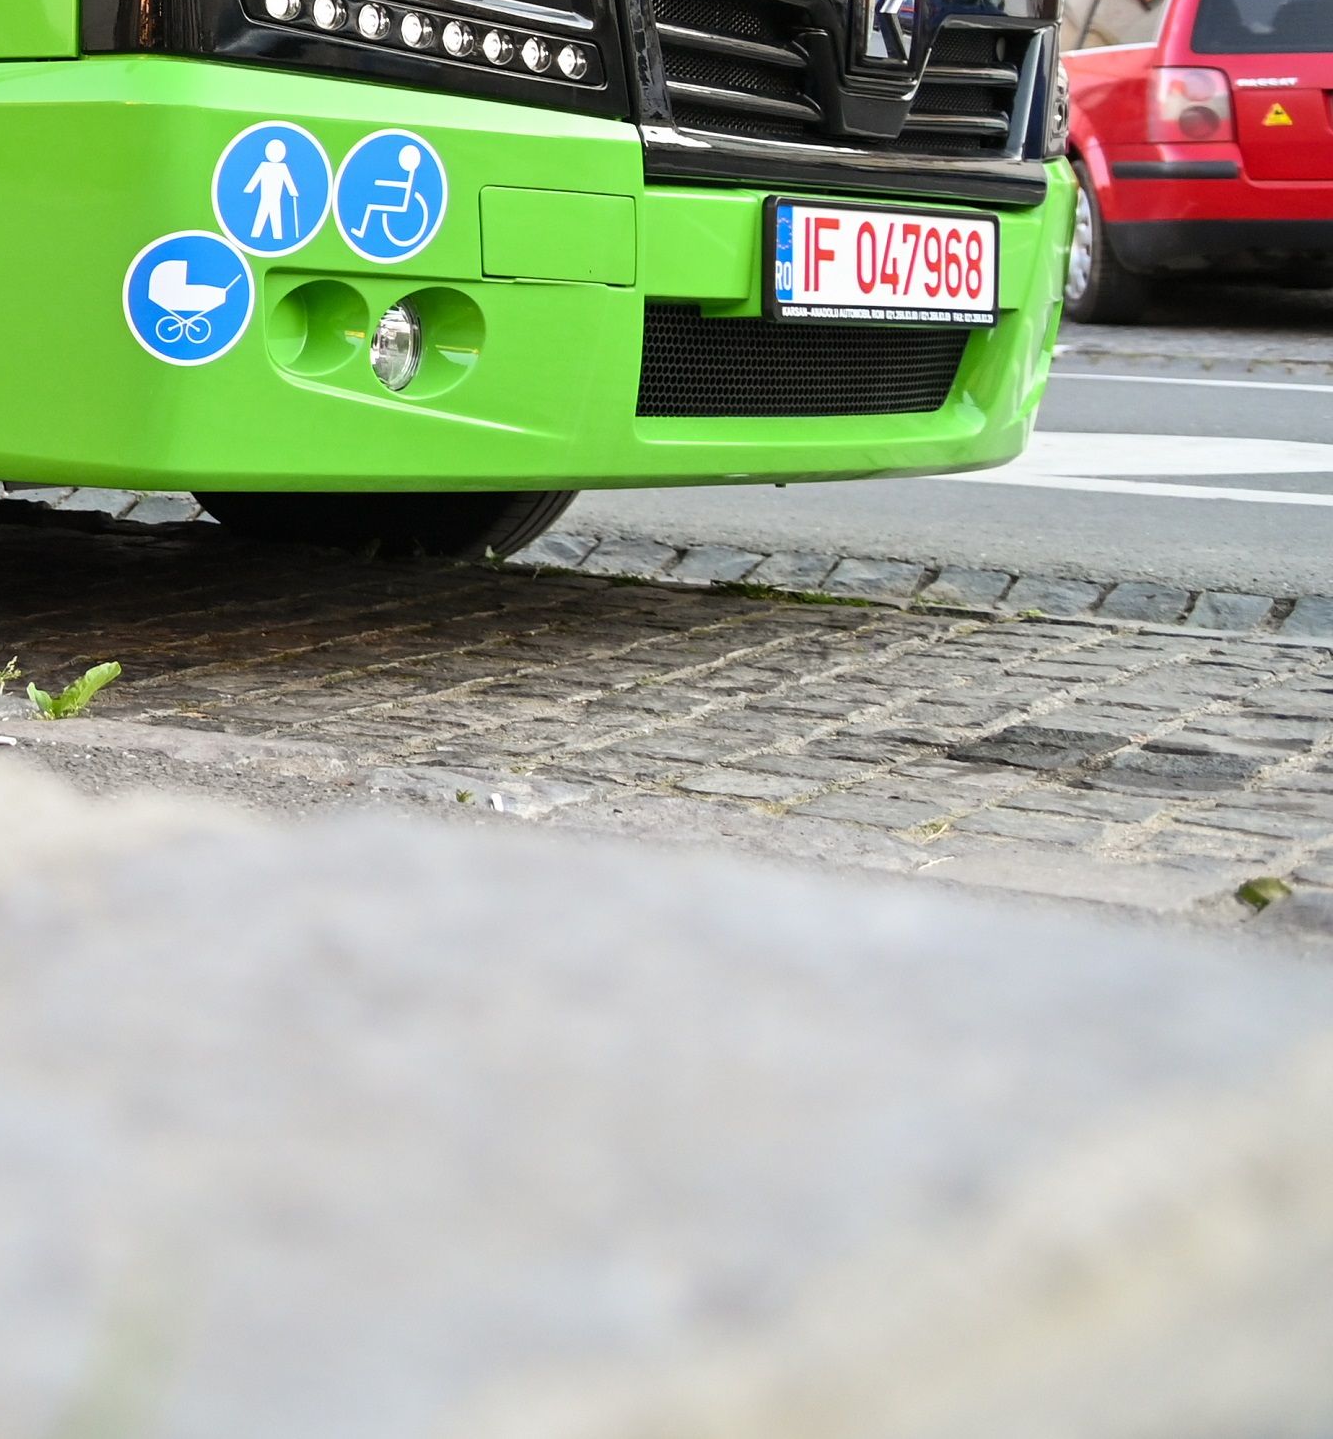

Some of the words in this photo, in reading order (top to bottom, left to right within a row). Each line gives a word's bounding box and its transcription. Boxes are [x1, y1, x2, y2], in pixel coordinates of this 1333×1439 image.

[775, 260, 793, 291] RO
[803, 216, 840, 292] IF
[856, 220, 983, 300] 047968
